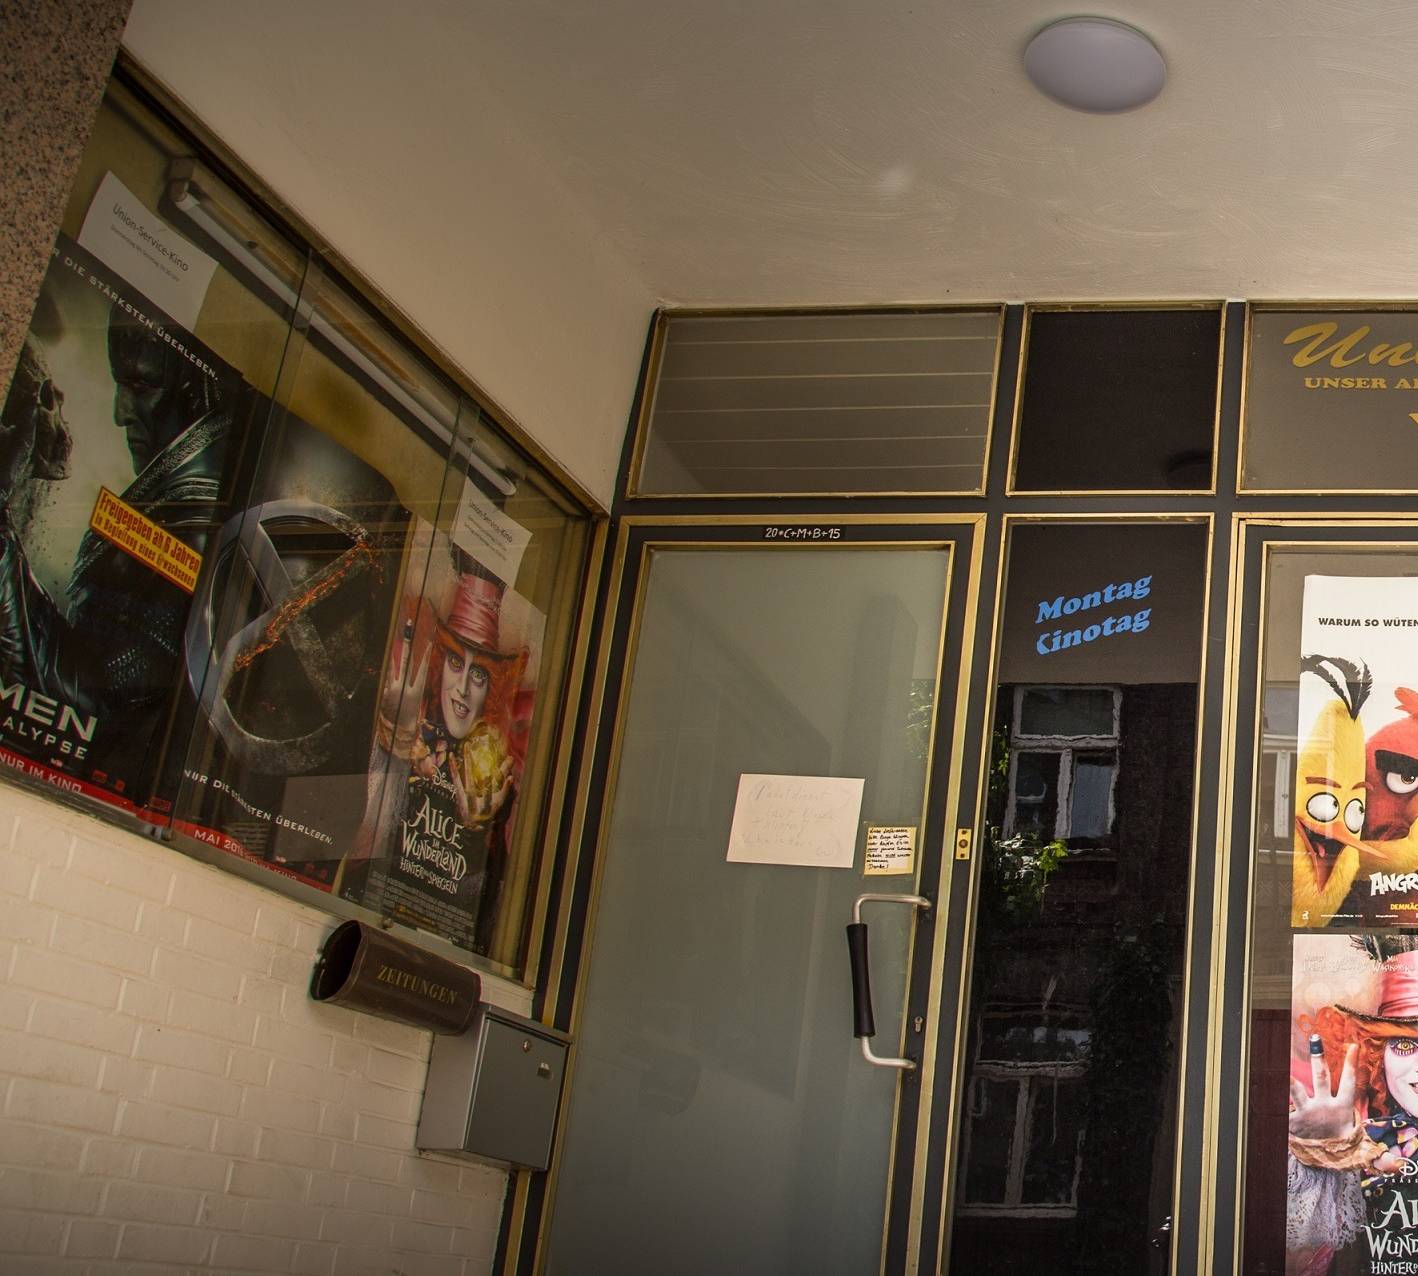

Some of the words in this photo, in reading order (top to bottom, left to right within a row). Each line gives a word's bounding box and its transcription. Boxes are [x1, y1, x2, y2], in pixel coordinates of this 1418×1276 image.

[65, 256, 86, 277] DIE
[89, 275, 155, 329] STÄRKSTEN
[157, 327, 219, 381] ÜBERLEBEN.
[1305, 377, 1387, 390] UNSER
[98, 492, 153, 541] Freigegeben
[170, 541, 200, 573] Jahren
[1035, 575, 1152, 624] Montag
[1318, 617, 1361, 627] WARUM
[1364, 618, 1379, 627] SO
[3, 716, 88, 760] ALYPSE
[29, 764, 44, 778] IM
[48, 773, 82, 794] KINO
[194, 830, 220, 846] MAI
[408, 794, 464, 849] ALICE
[400, 818, 467, 881] WUNDERLAND
[377, 965, 457, 1005] ZEITUNGEN
[1370, 1261, 1414, 1275] HINTER
